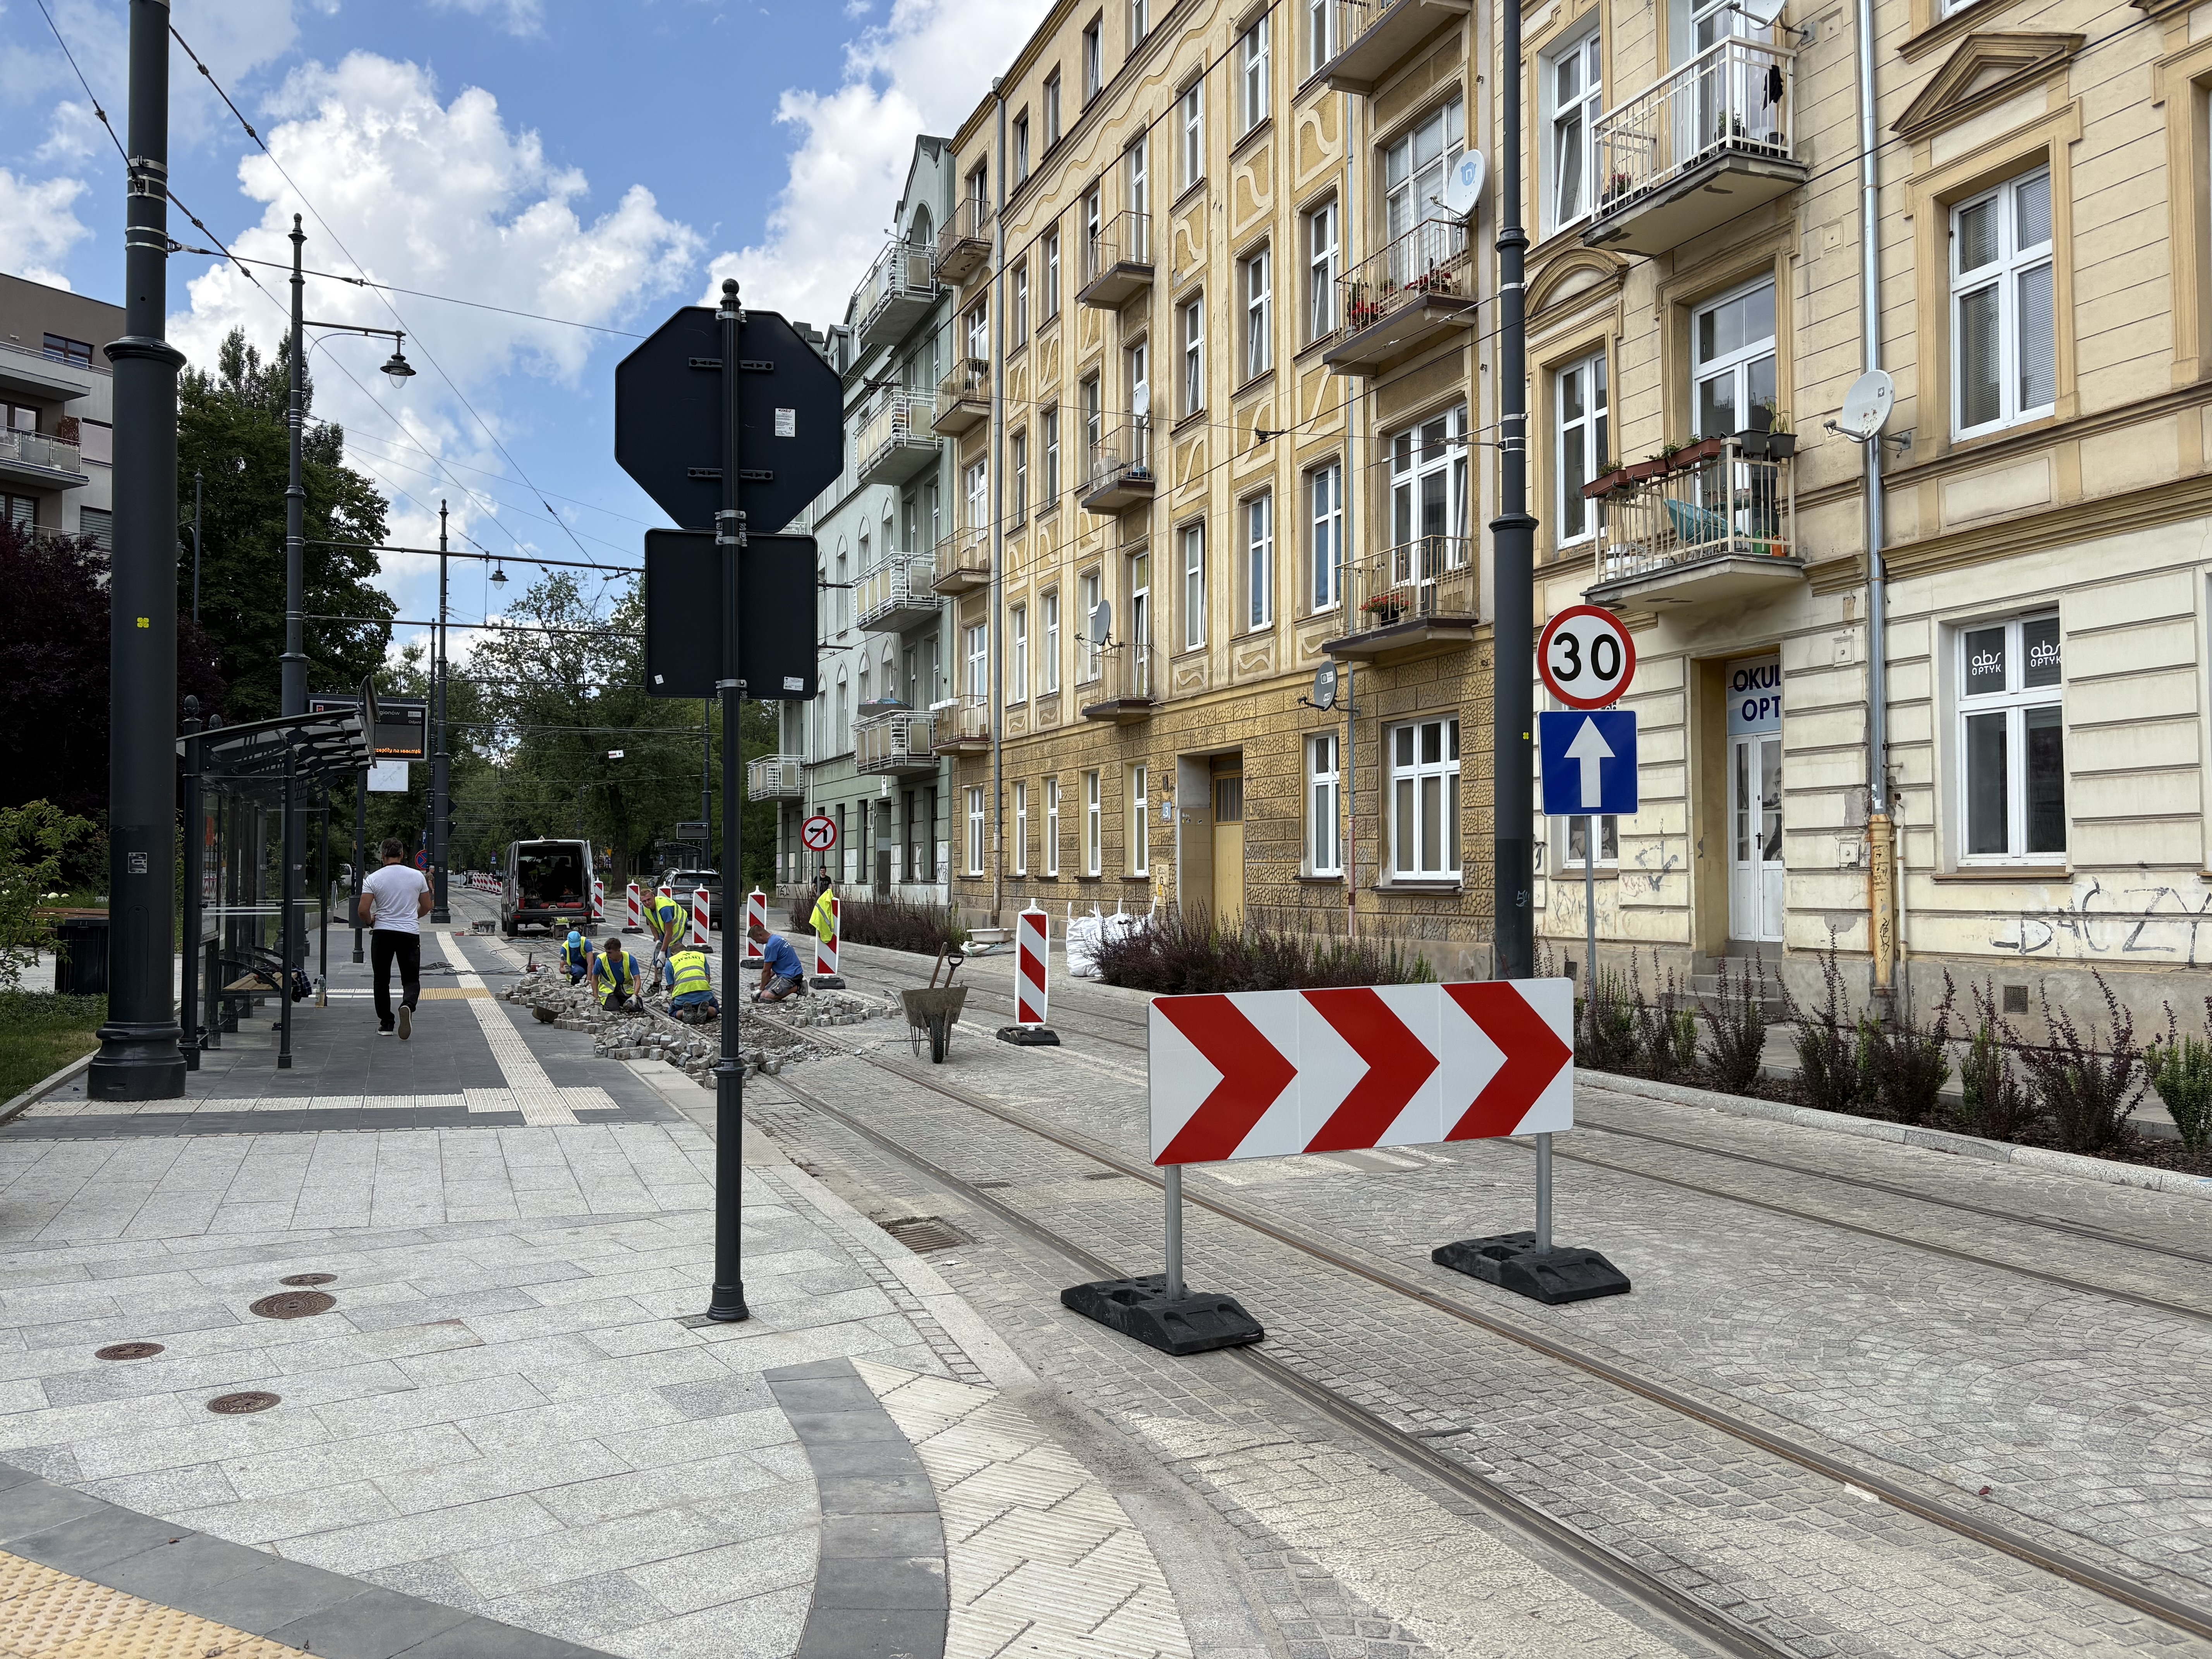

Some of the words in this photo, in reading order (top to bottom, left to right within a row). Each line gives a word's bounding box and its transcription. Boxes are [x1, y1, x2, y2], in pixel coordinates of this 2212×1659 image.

[1552, 632, 1620, 682] 30
[1972, 664, 2001, 675] OPTYK
[2030, 656, 2061, 667] OPTYK
[1733, 664, 1781, 692] OKUL
[1742, 696, 1781, 721] OPT
